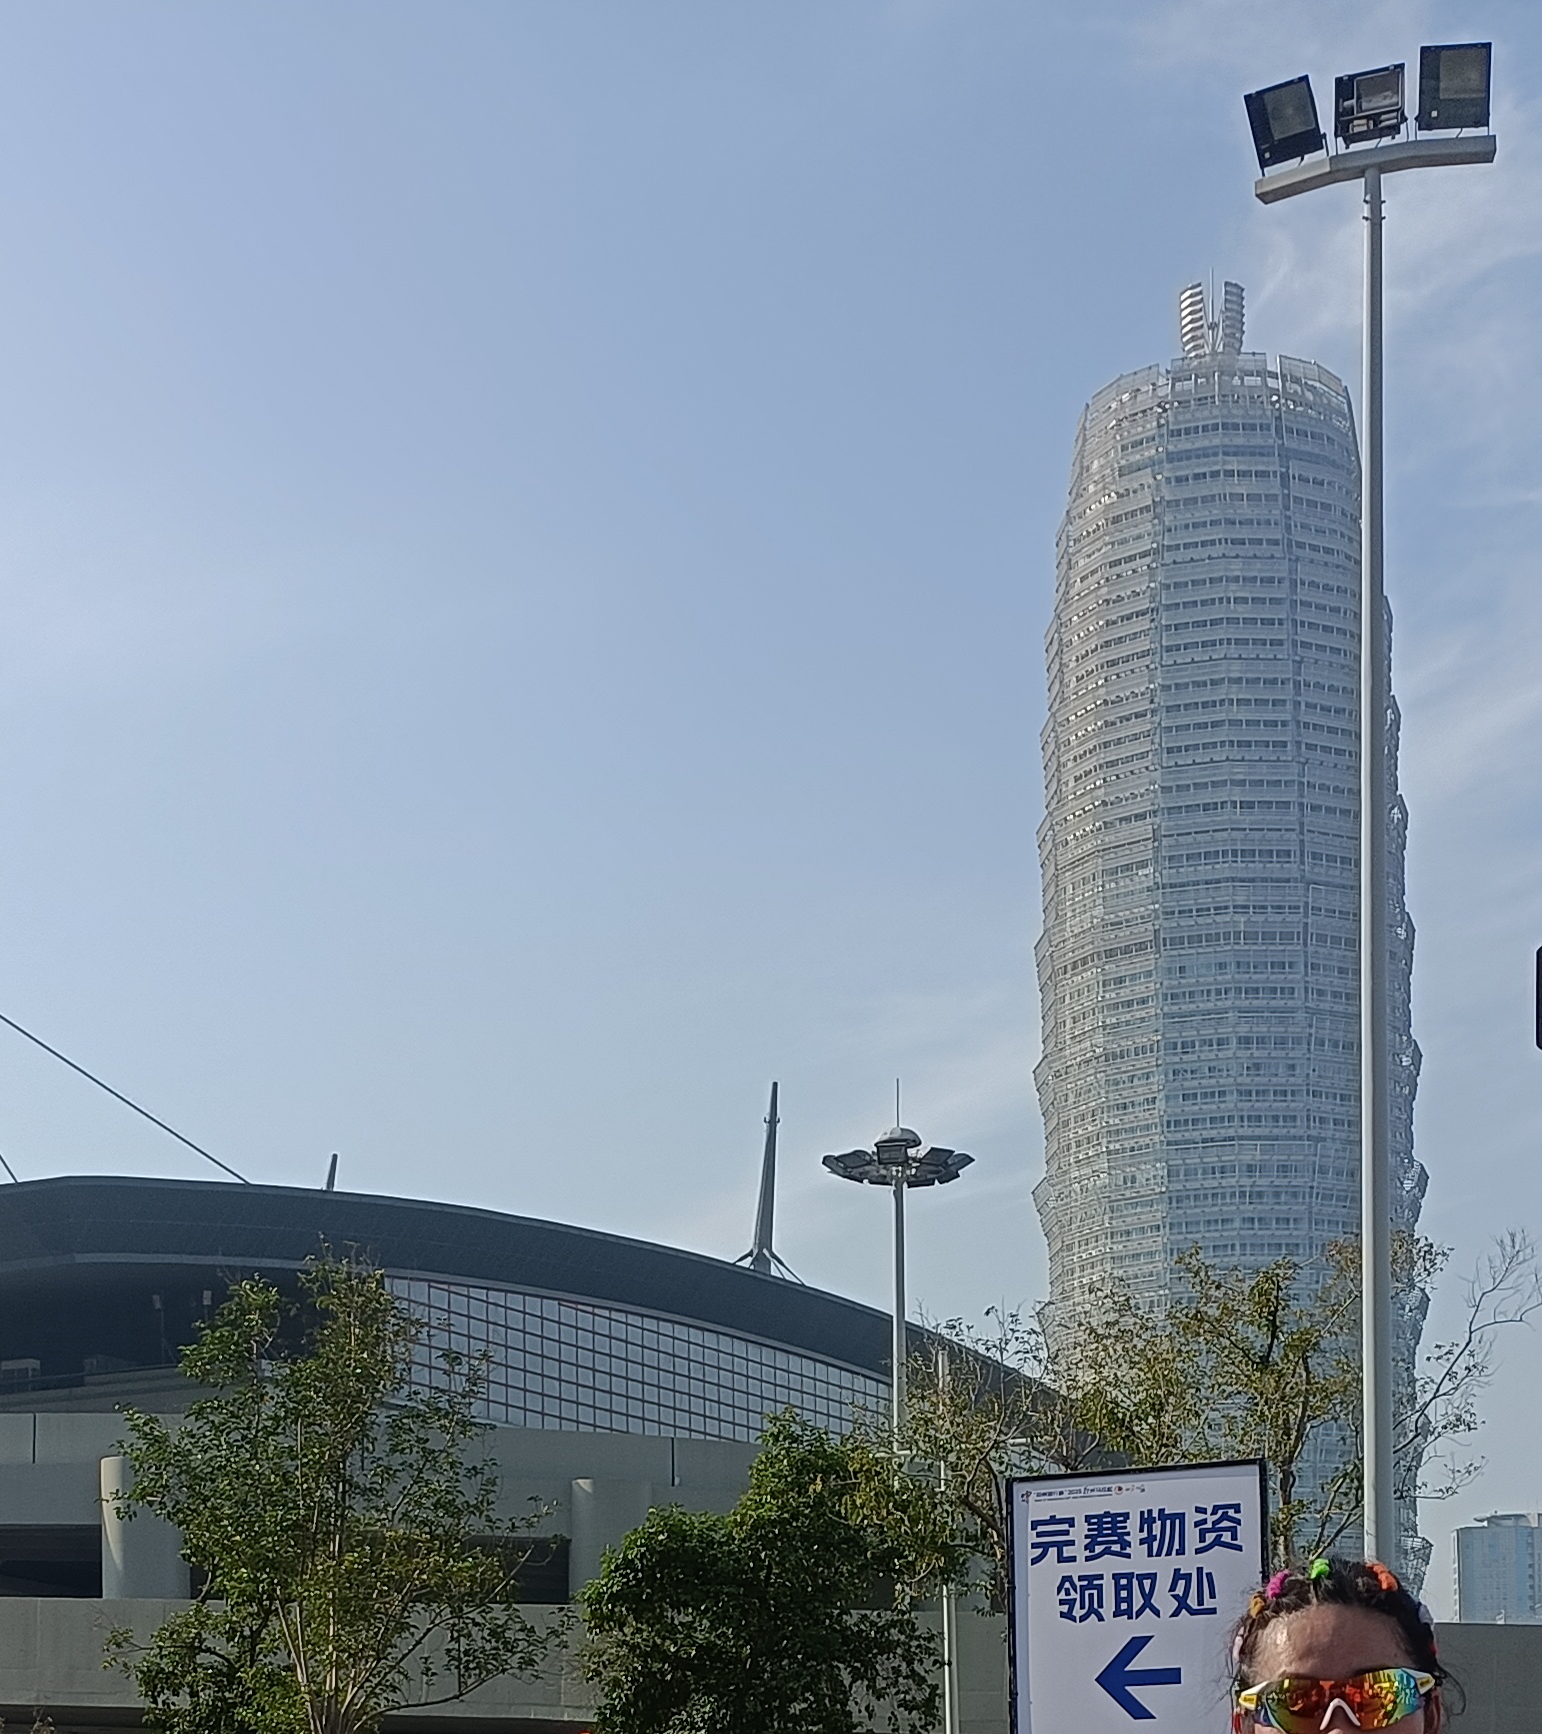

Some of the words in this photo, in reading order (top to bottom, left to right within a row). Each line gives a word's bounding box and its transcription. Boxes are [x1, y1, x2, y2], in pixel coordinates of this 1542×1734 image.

[1030, 1503, 1243, 1566] 完赛物资
[1057, 1567, 1218, 1624] 领取处
